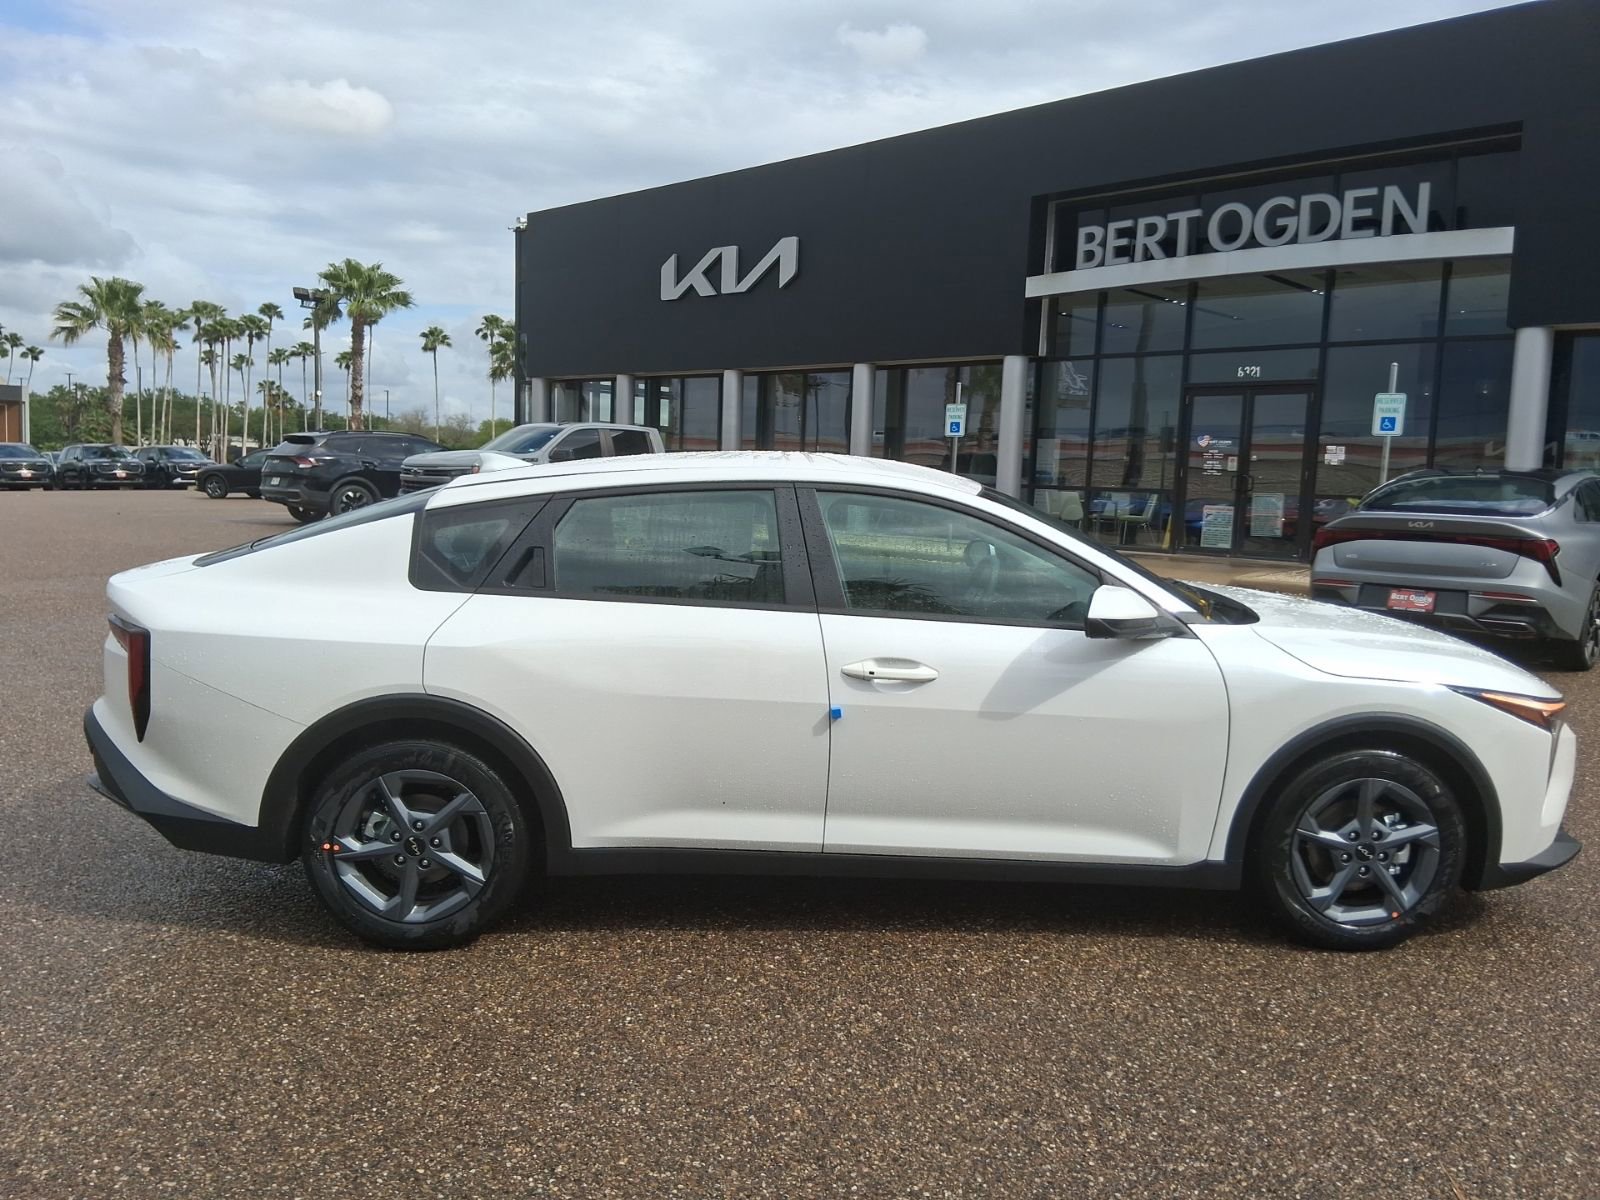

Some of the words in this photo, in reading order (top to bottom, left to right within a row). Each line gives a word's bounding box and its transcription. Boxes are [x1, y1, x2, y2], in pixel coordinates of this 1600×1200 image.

[1075, 208, 1203, 271] BERT
[1207, 181, 1432, 252] OGDEN
[660, 235, 800, 302] KIA
